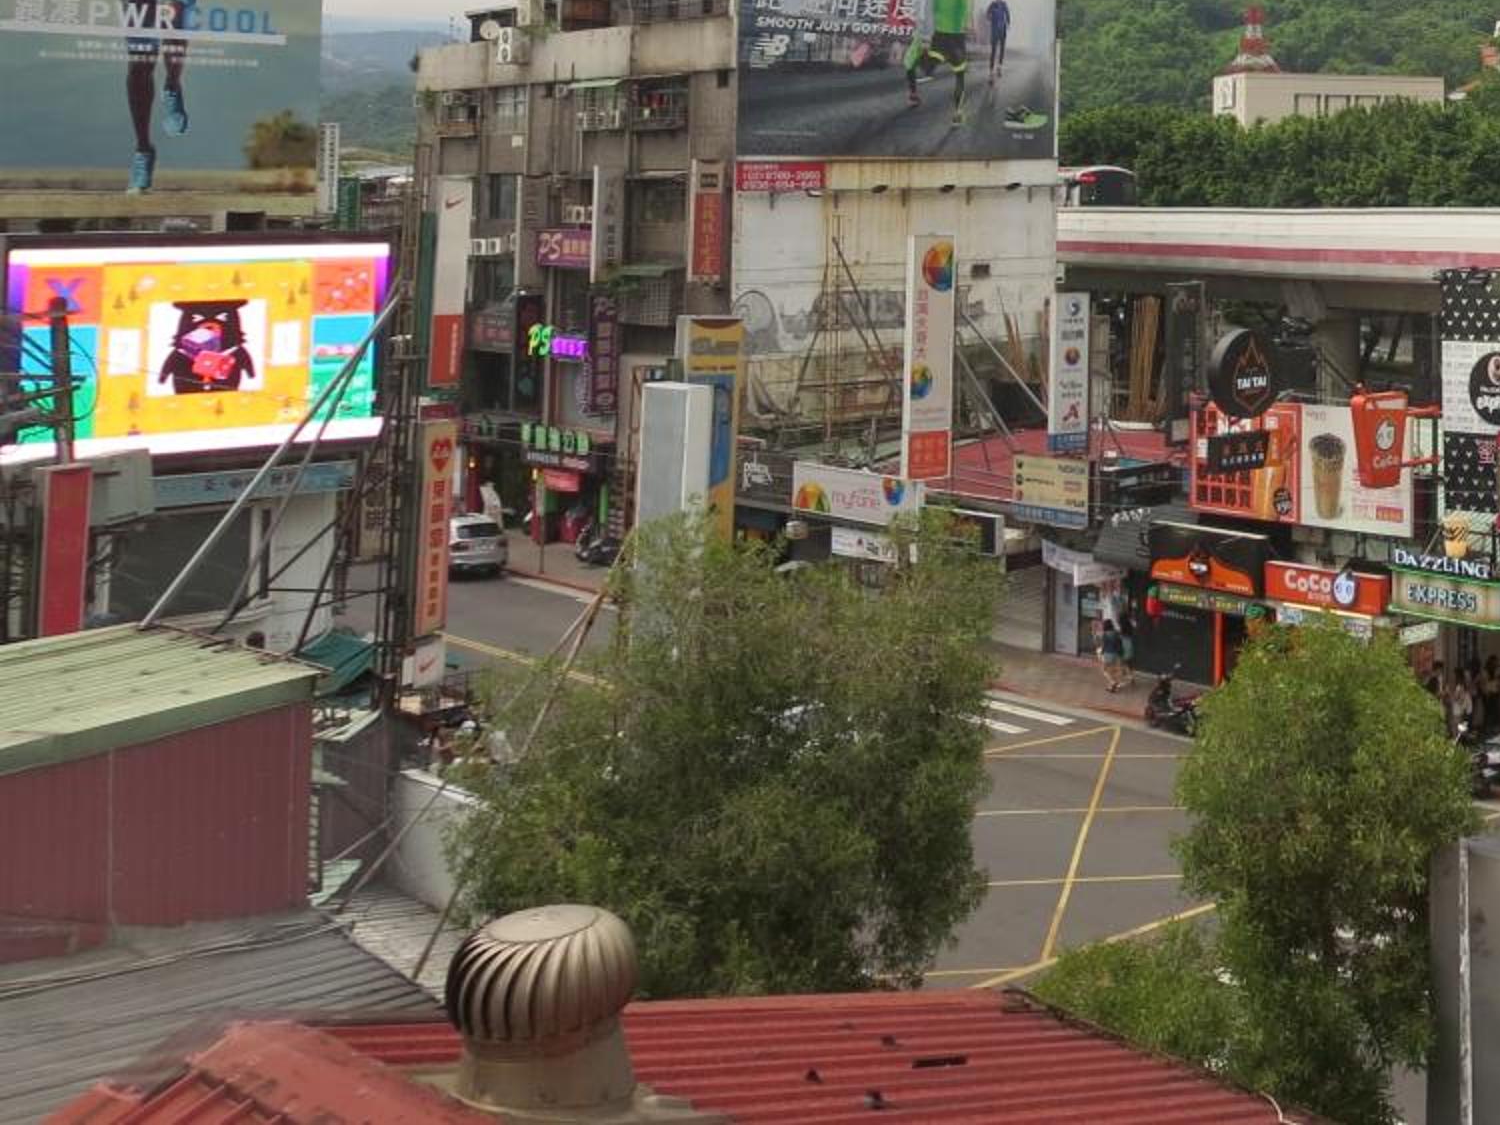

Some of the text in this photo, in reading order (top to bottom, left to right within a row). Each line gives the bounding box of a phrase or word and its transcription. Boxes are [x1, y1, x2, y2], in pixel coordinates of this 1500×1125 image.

[757, 16, 813, 30] SMOOTH
[816, 20, 849, 33] JUST
[1394, 548, 1490, 580] DAZZLING
[1284, 568, 1332, 593] CoCo
[1407, 583, 1477, 613] EXPRESS
